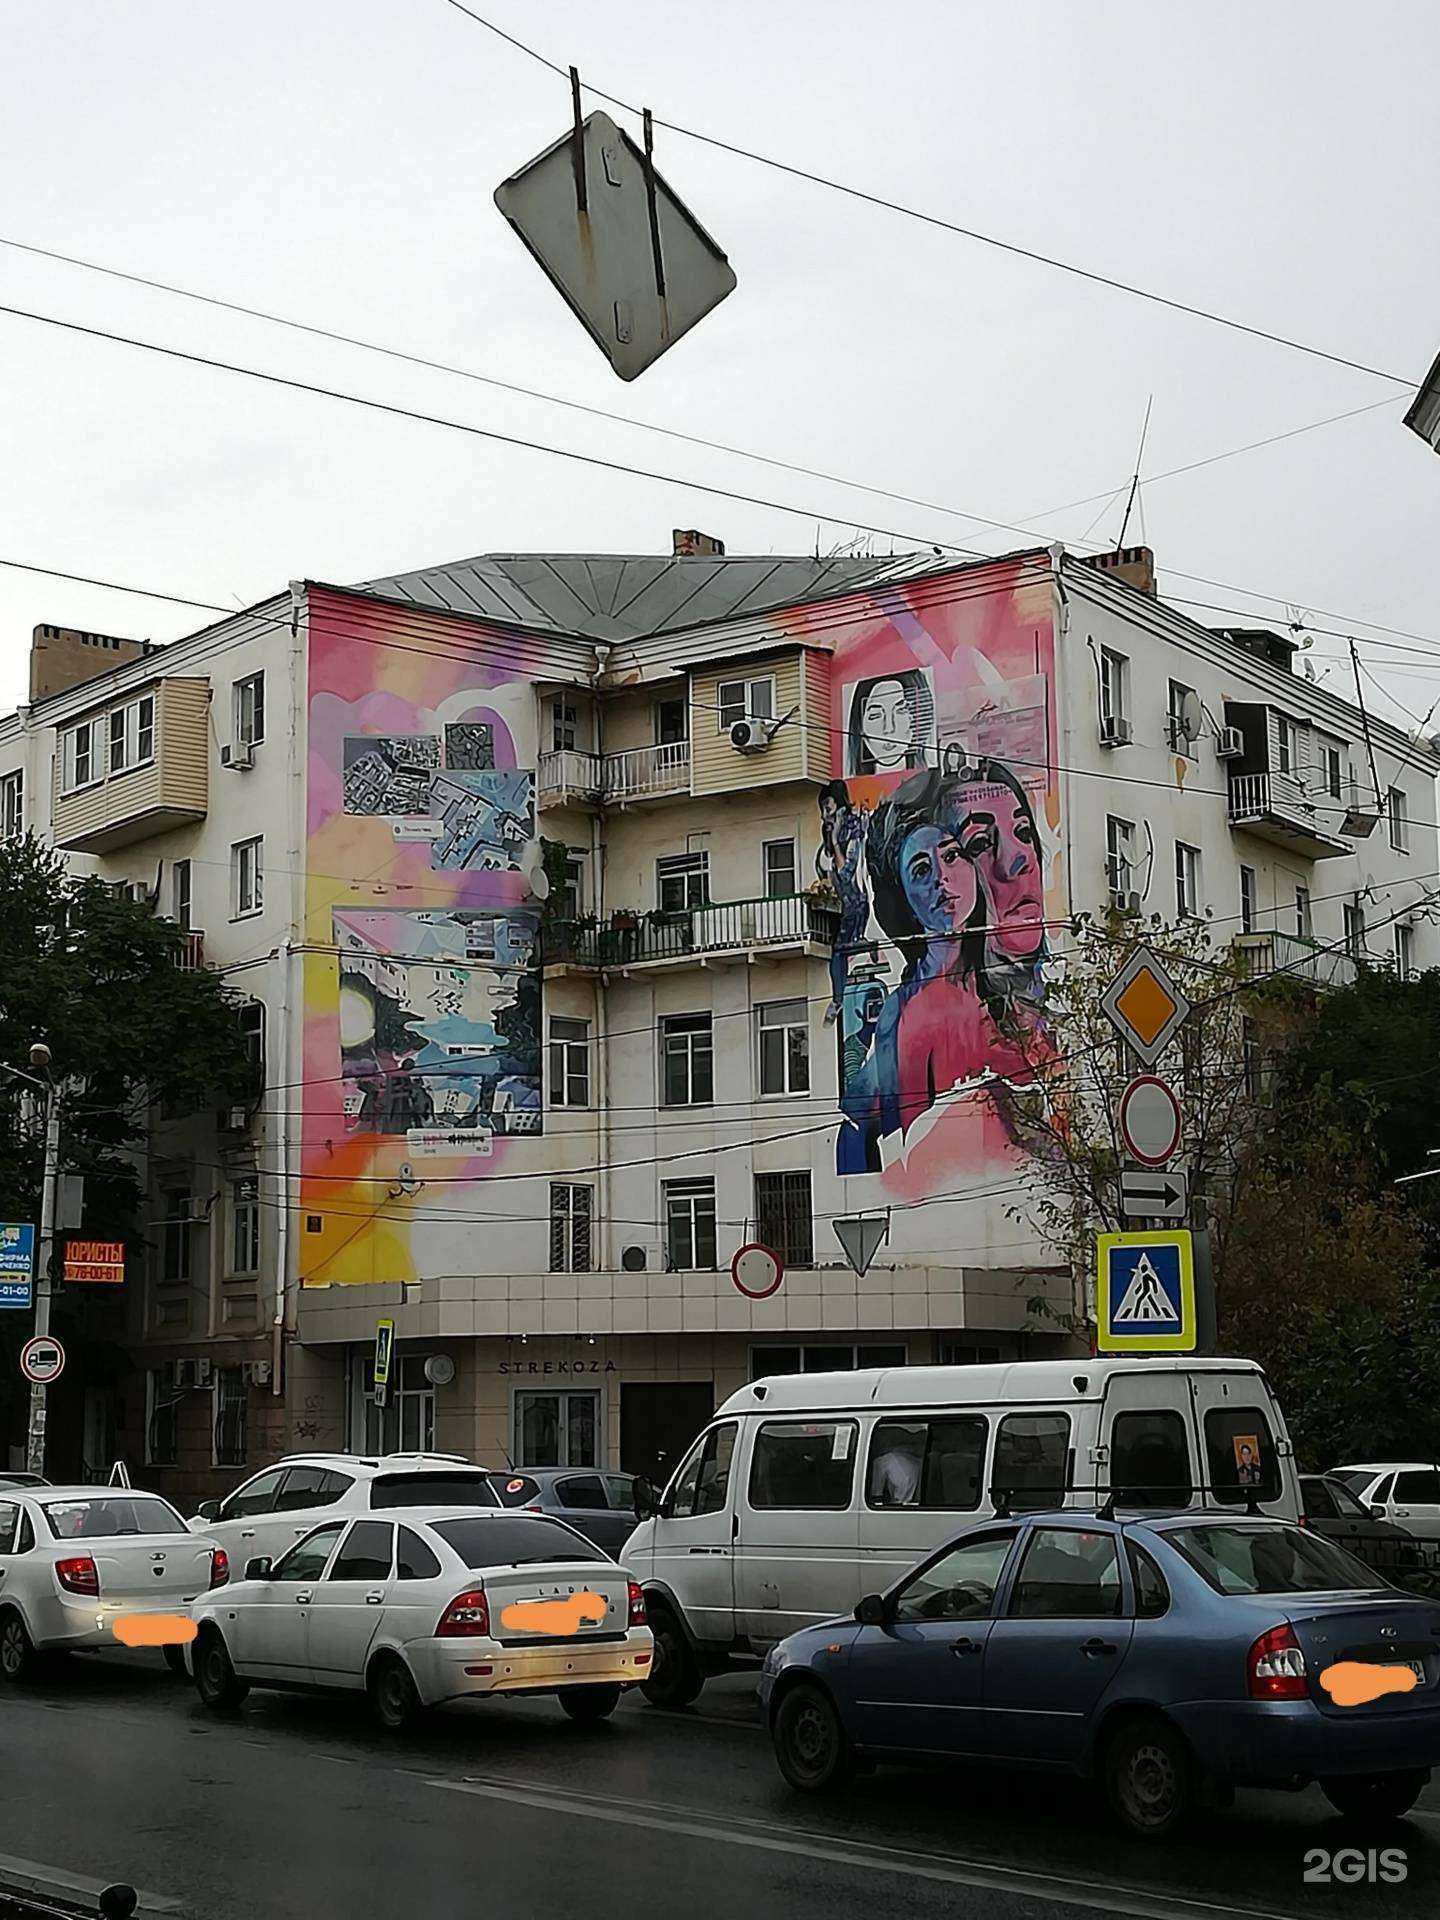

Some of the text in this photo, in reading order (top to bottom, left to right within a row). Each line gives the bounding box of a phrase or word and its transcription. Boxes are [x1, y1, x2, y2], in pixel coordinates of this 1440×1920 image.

[67, 1243, 123, 1262] ЮРИСТЫ
[499, 1360, 616, 1374] STREKOZA
[538, 1585, 589, 1595] LADA
